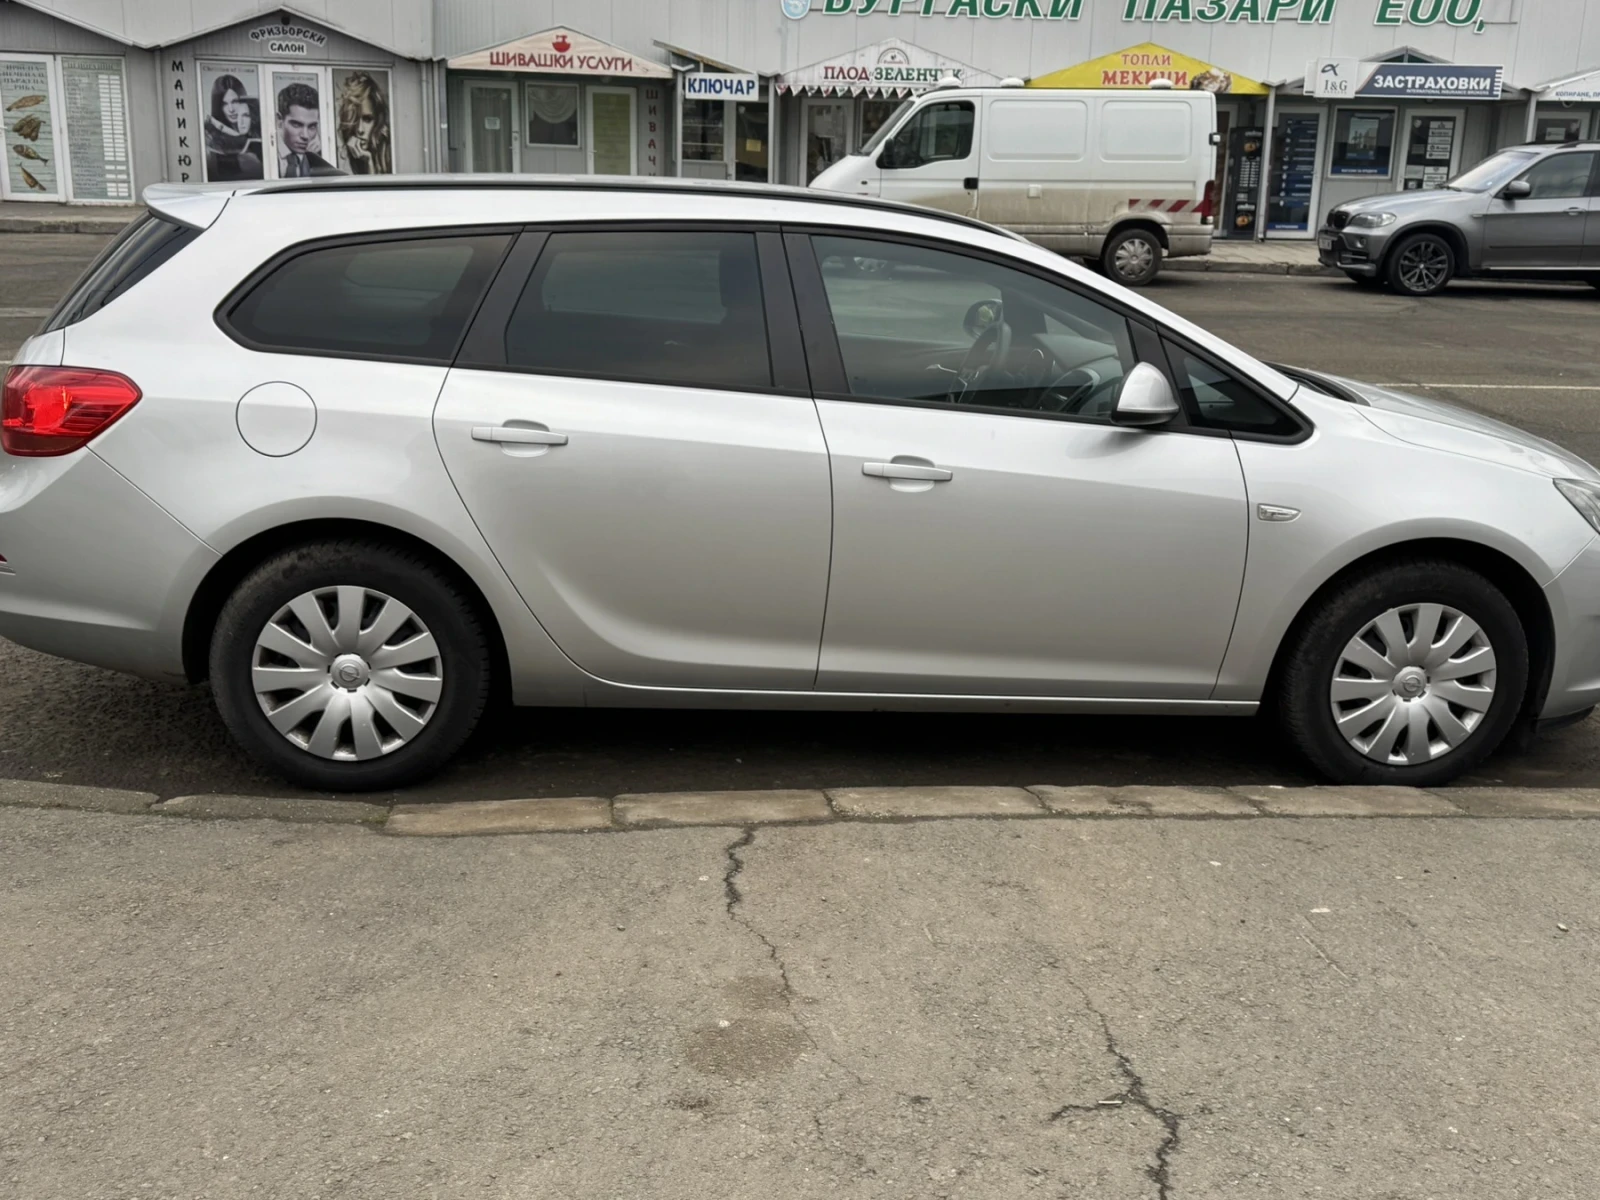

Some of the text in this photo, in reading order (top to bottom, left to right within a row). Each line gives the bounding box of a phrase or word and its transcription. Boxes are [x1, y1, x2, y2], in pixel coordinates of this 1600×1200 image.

[1122, 0, 1336, 23] ПАЗАРИ
[250, 25, 326, 45] ФРИЗЬОРСКИ
[270, 42, 305, 53] САЛОН
[489, 51, 633, 71] ШИВАШКИ УСЛУГИ
[1121, 54, 1171, 66] ТОПЛИ
[823, 66, 870, 82] ПЛОД
[874, 66, 962, 82] ЗЕЛЕНЧК
[1373, 75, 1491, 91] ЗАСТРАХОВКИ
[688, 77, 756, 95] КЛЮЧАР
[171, 59, 192, 183] МАНИКЮР
